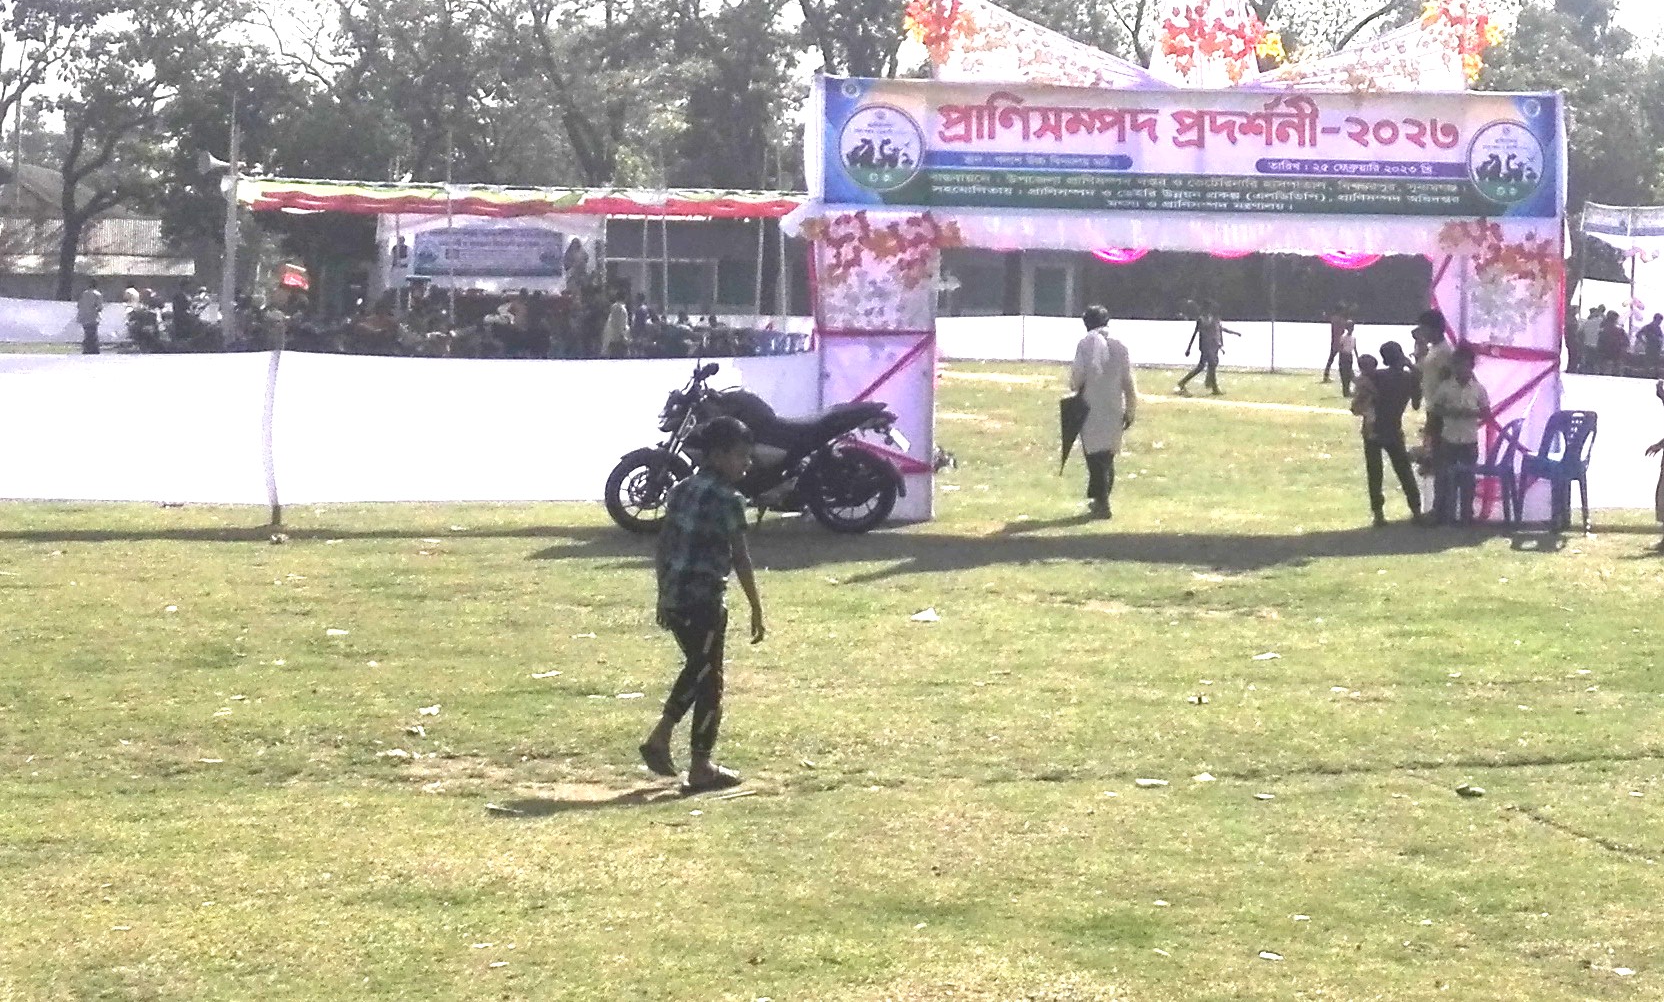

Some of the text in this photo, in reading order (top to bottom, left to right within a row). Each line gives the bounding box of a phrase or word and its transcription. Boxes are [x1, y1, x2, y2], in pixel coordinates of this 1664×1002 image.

[937, 91, 1460, 148] প্রাণিসম্পদ প্রদর্শনী-২০২৩
[1268, 159, 1300, 171] তারিখ
[1384, 165, 1417, 174] ২০২৩
